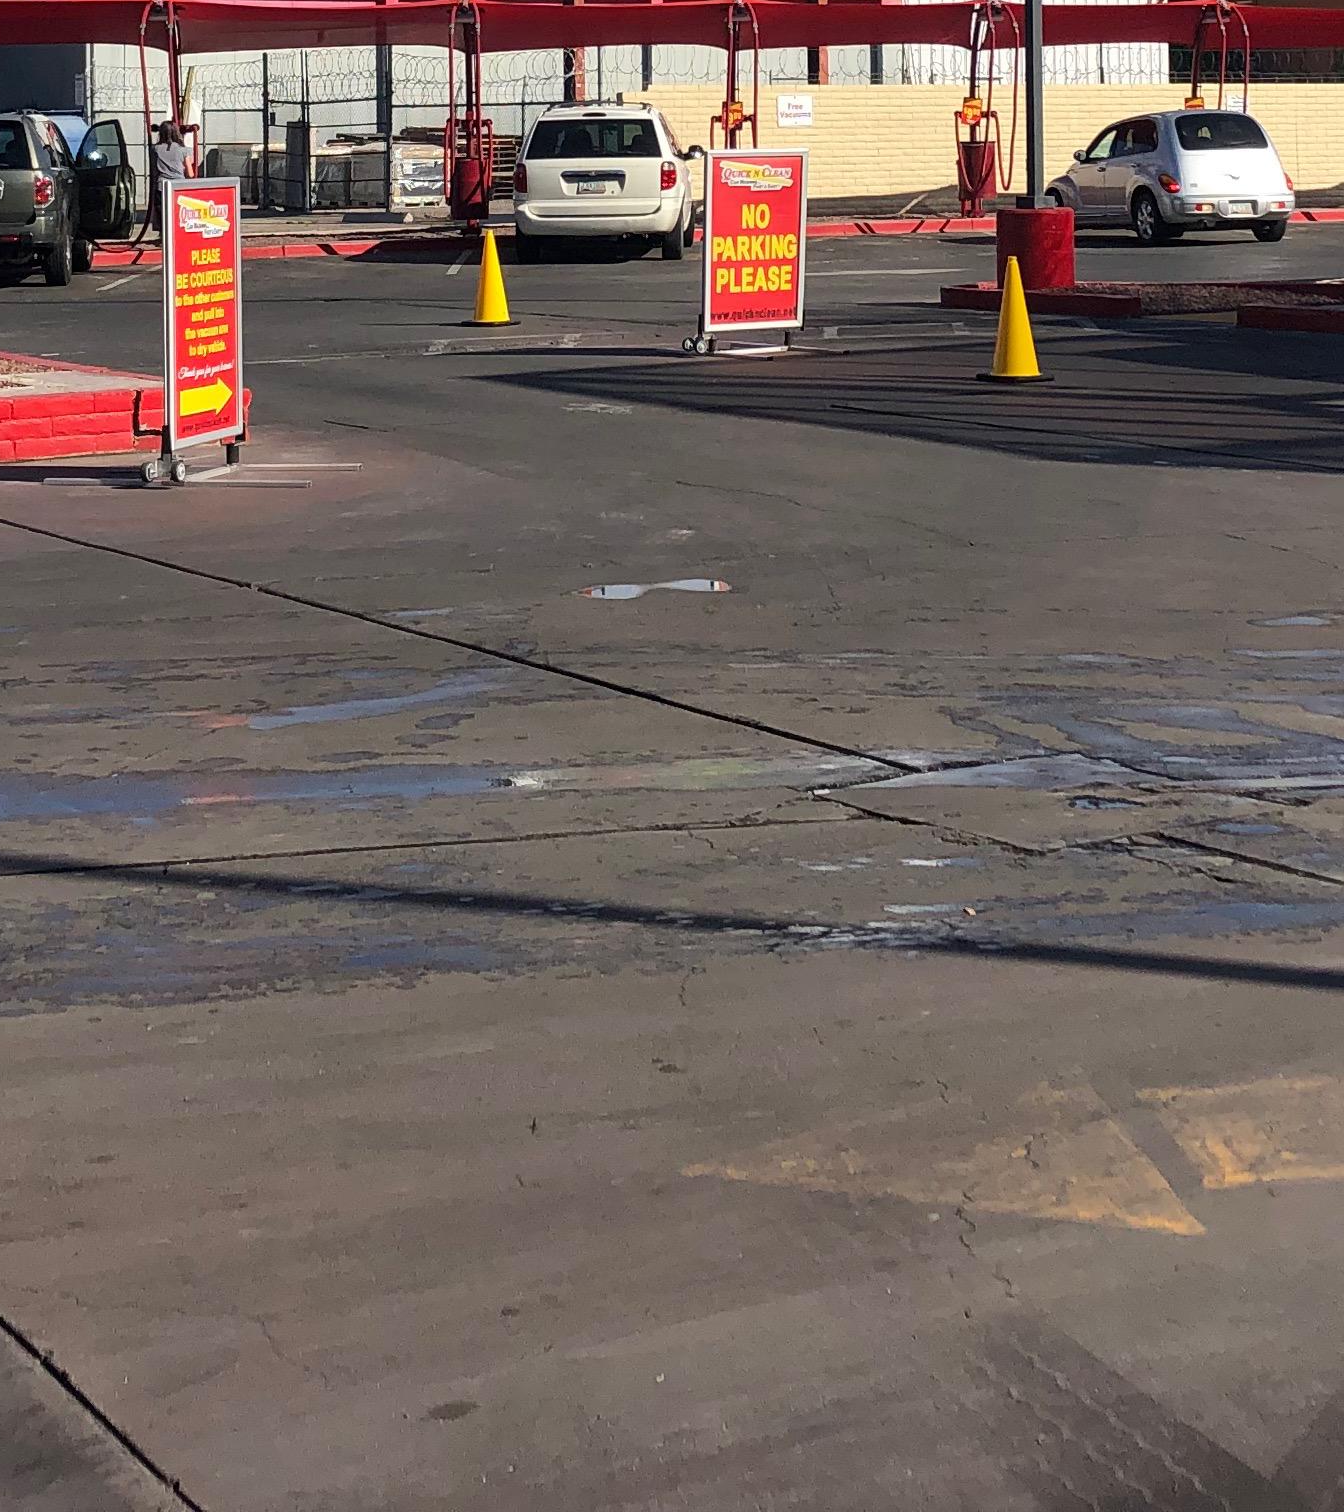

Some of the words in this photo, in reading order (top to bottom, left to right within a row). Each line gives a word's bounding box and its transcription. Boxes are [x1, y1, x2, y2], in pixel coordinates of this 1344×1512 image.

[741, 203, 770, 230] NO
[191, 248, 221, 266] PLEASE
[712, 233, 798, 263] PARKING
[176, 273, 189, 290] BE
[190, 268, 233, 289] COURTEOUS
[716, 265, 793, 294] PLEASE
